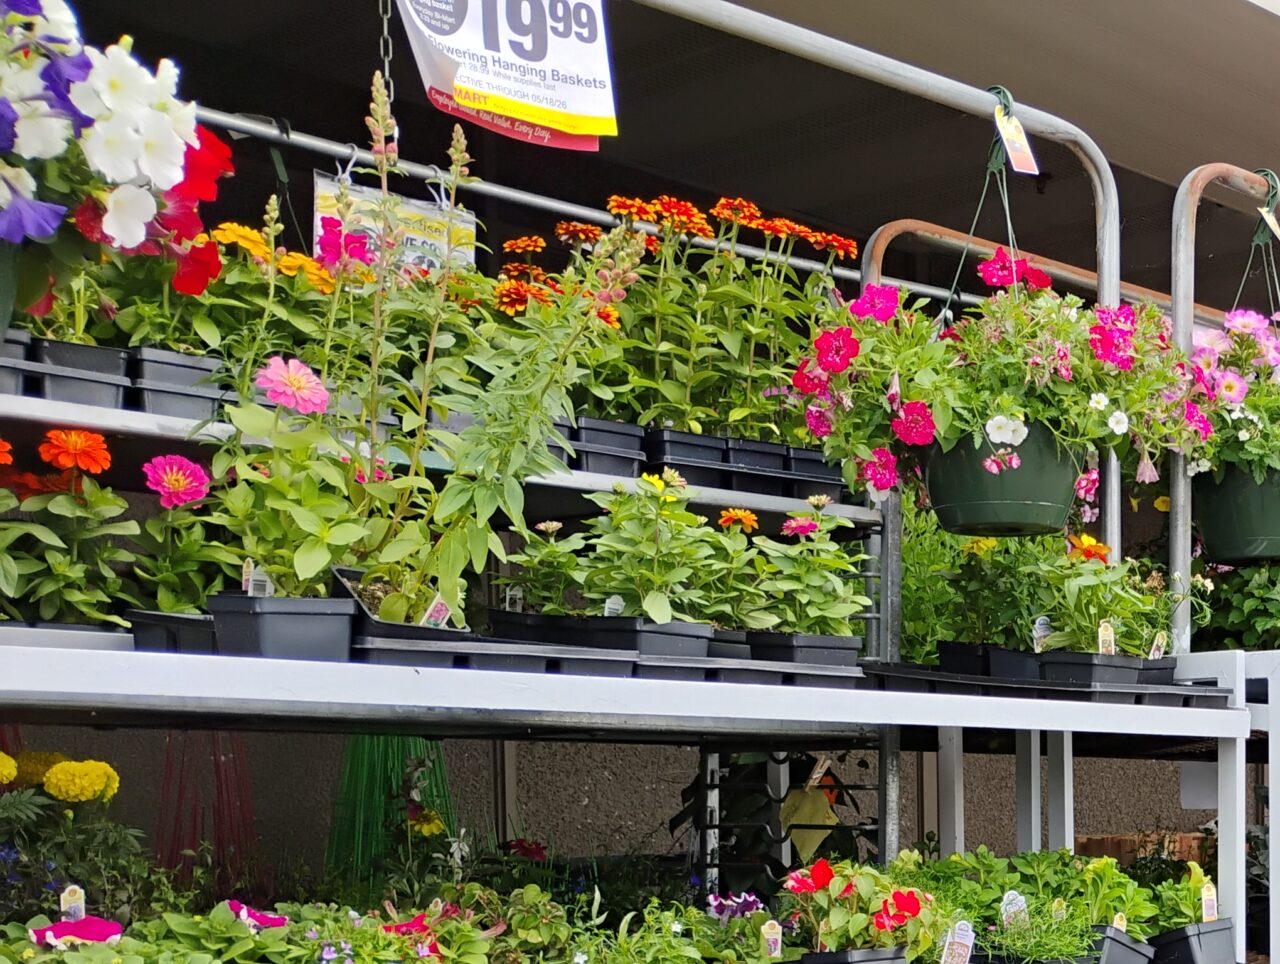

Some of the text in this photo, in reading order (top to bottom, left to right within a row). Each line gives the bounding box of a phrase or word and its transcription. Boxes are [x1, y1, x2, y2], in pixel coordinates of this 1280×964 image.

[491, 55, 547, 82] Hanging
[551, 69, 607, 90] Baskets
[487, 80, 530, 100] THROUGH
[514, 121, 534, 140] Every
[534, 126, 551, 143] Day.
